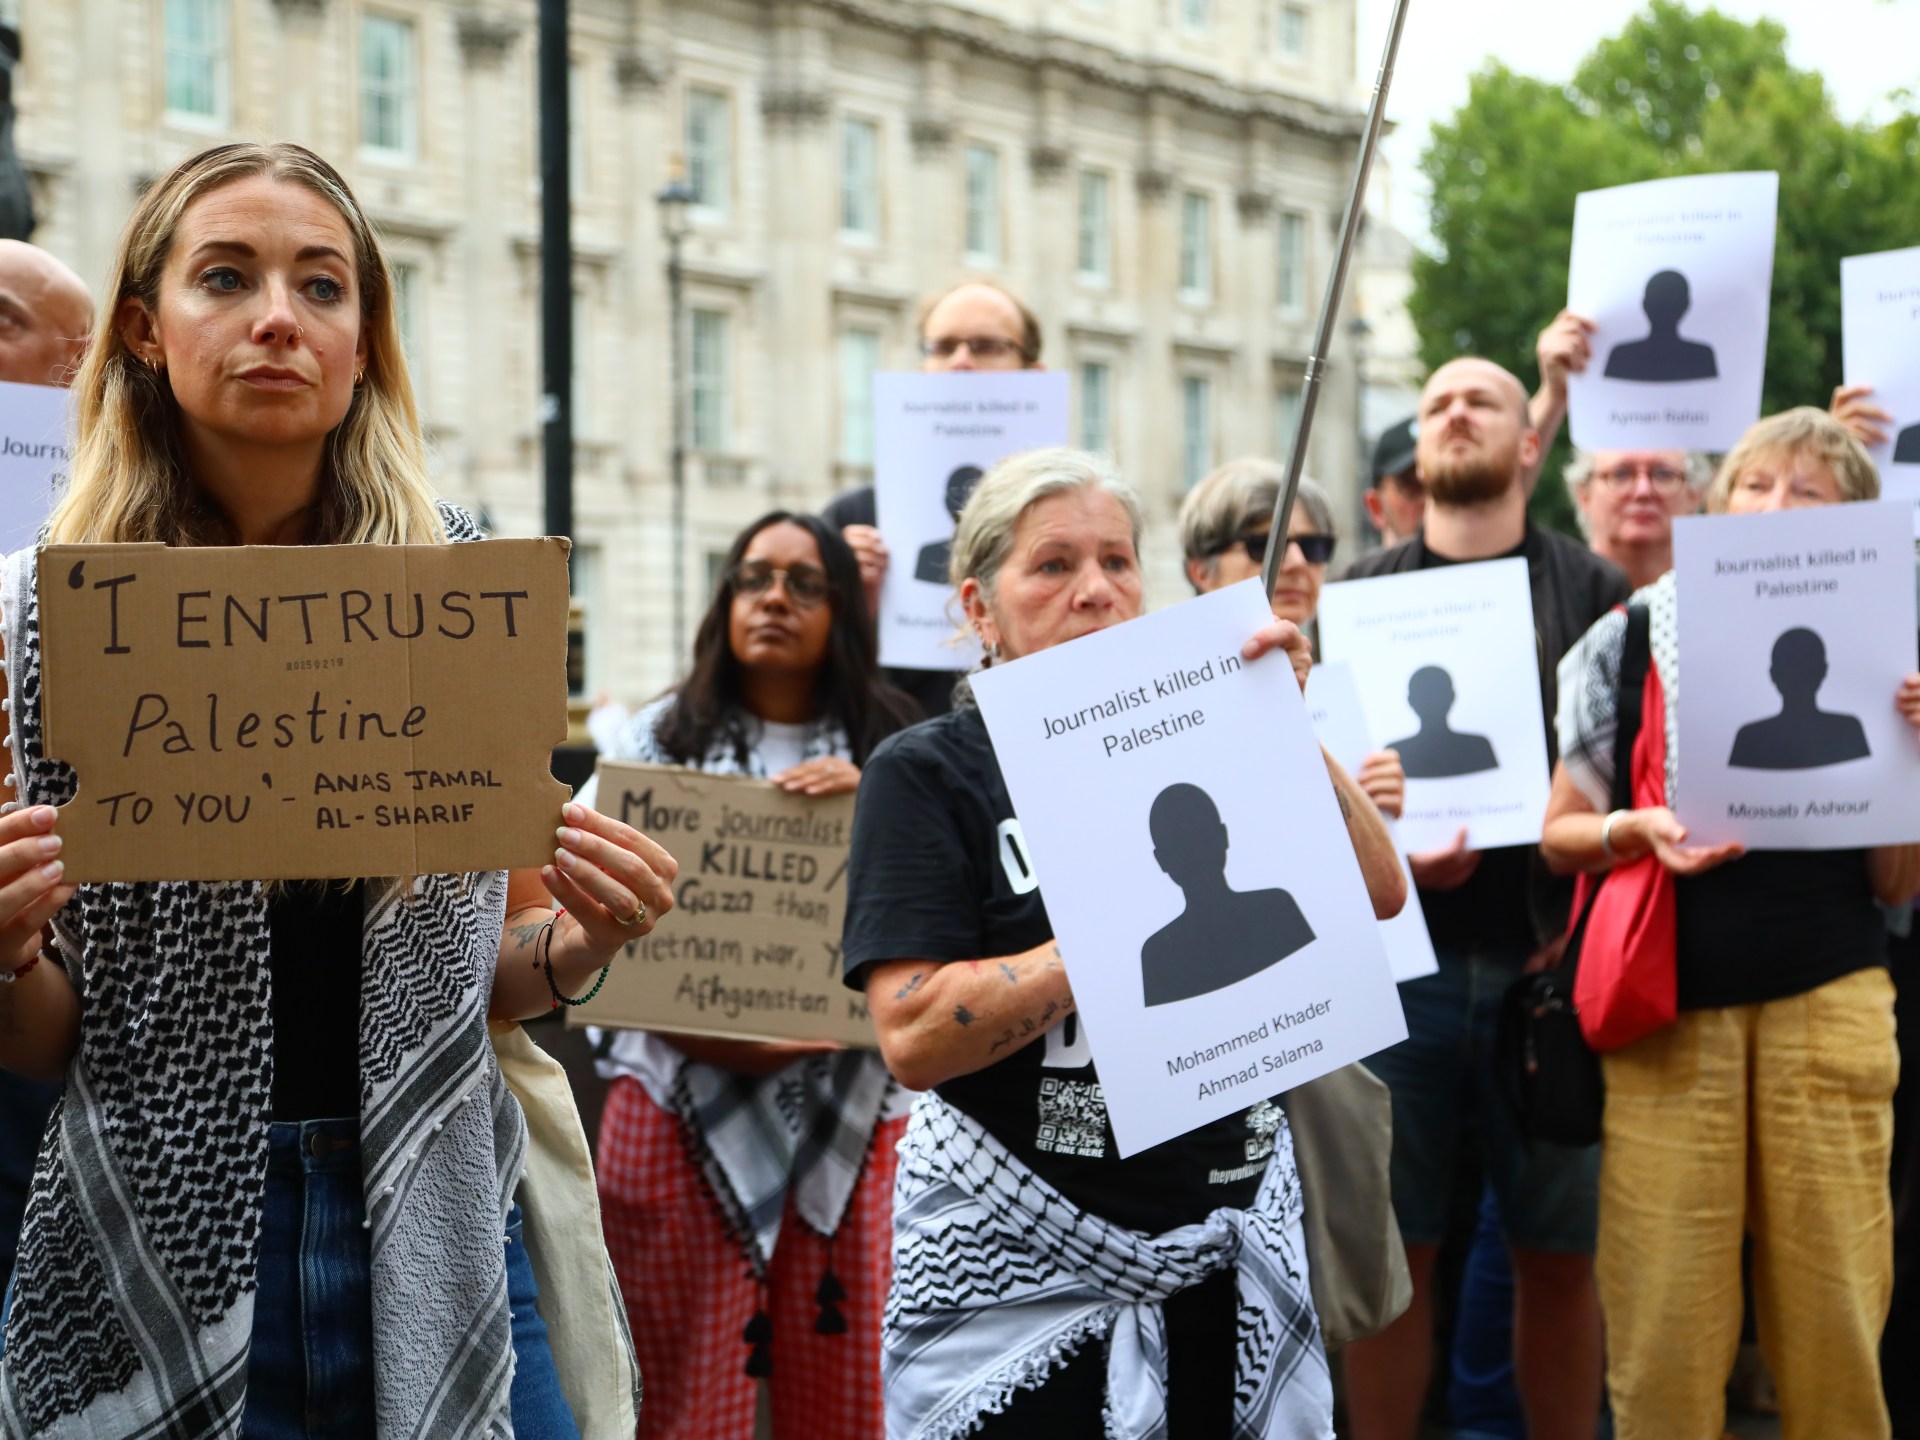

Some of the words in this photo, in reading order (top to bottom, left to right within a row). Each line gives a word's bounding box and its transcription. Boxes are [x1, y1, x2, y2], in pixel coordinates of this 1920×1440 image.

[1714, 551, 1800, 577] Journalist
[1807, 546, 1856, 569] killed
[1860, 546, 1878, 563] in
[1755, 577, 1838, 600] Palestine
[177, 590, 529, 649] ENTRUST
[1043, 685, 1151, 740] Journalist
[1153, 660, 1214, 699] killed
[1218, 655, 1241, 676] in
[123, 691, 426, 758] Palestine
[1102, 709, 1206, 758] Palestine
[97, 791, 153, 827] TO
[314, 772, 392, 796] ANAS
[410, 769, 502, 789] JAMAL
[621, 787, 699, 832] More
[715, 803, 850, 846] journalist
[1727, 800, 1798, 820] Mossab
[1804, 799, 1870, 818] Ashour
[700, 839, 819, 885] KILLED
[677, 879, 754, 916] Gaza
[774, 890, 830, 927] than
[624, 932, 744, 967] Vietnam
[1166, 1022, 1270, 1077] Mohammed
[1272, 999, 1333, 1034] Khader
[1198, 1062, 1260, 1101] Ahmad
[1261, 1038, 1325, 1073] Salama
[1035, 1139, 1055, 1152] GET
[1055, 1143, 1076, 1155] ONE
[1077, 1147, 1105, 1159] HERE
